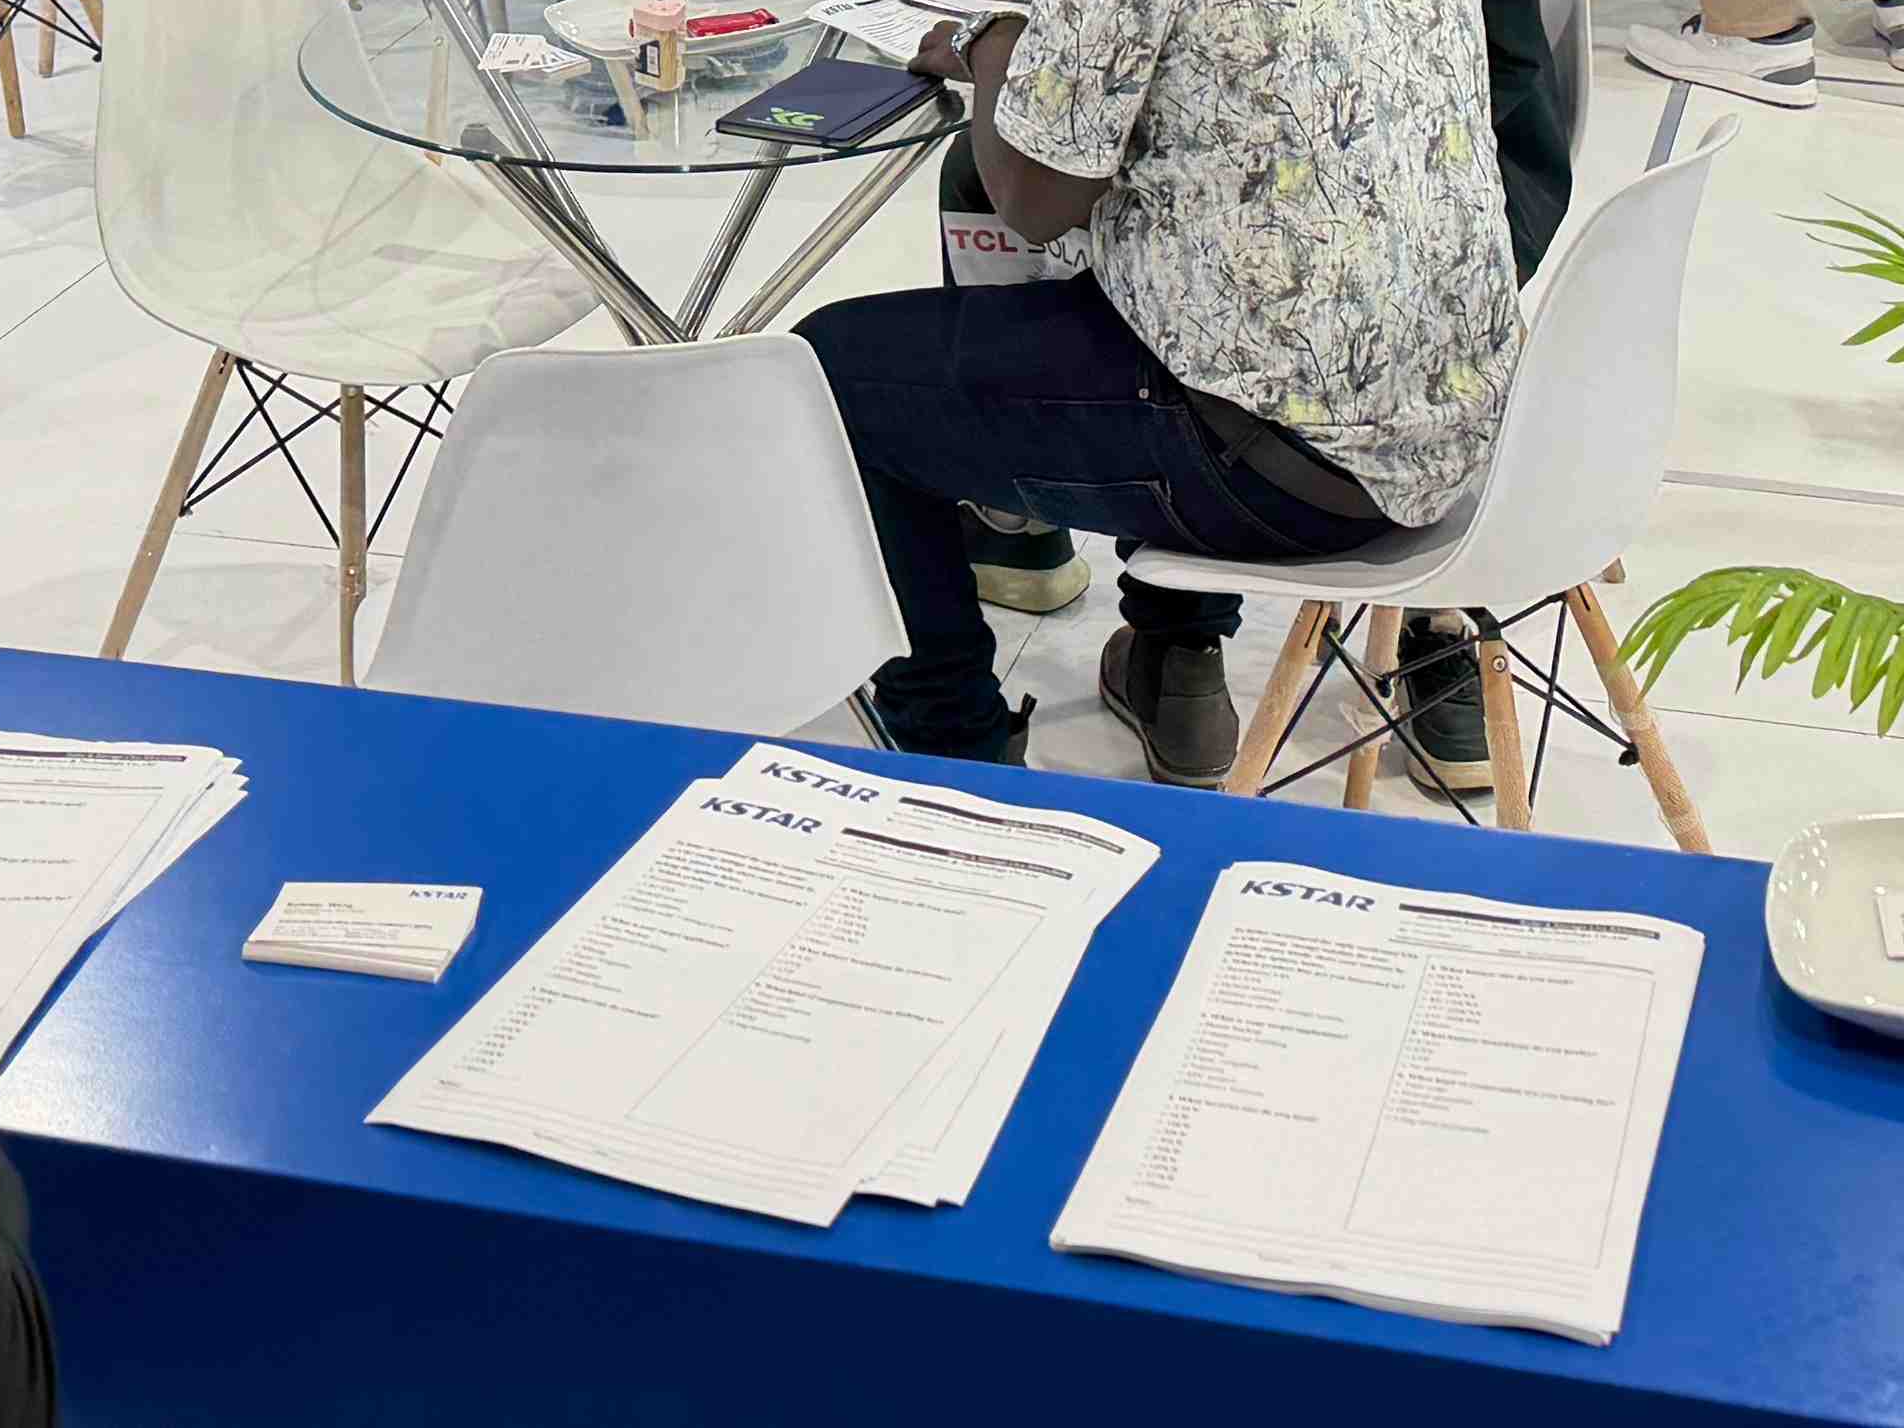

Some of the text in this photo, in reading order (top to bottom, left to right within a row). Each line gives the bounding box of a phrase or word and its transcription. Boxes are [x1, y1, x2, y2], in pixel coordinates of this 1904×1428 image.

[949, 229, 1018, 253] TCL
[759, 762, 881, 804] KSTAR
[699, 795, 824, 838] KSTAR
[1240, 880, 1376, 914] KSTAR
